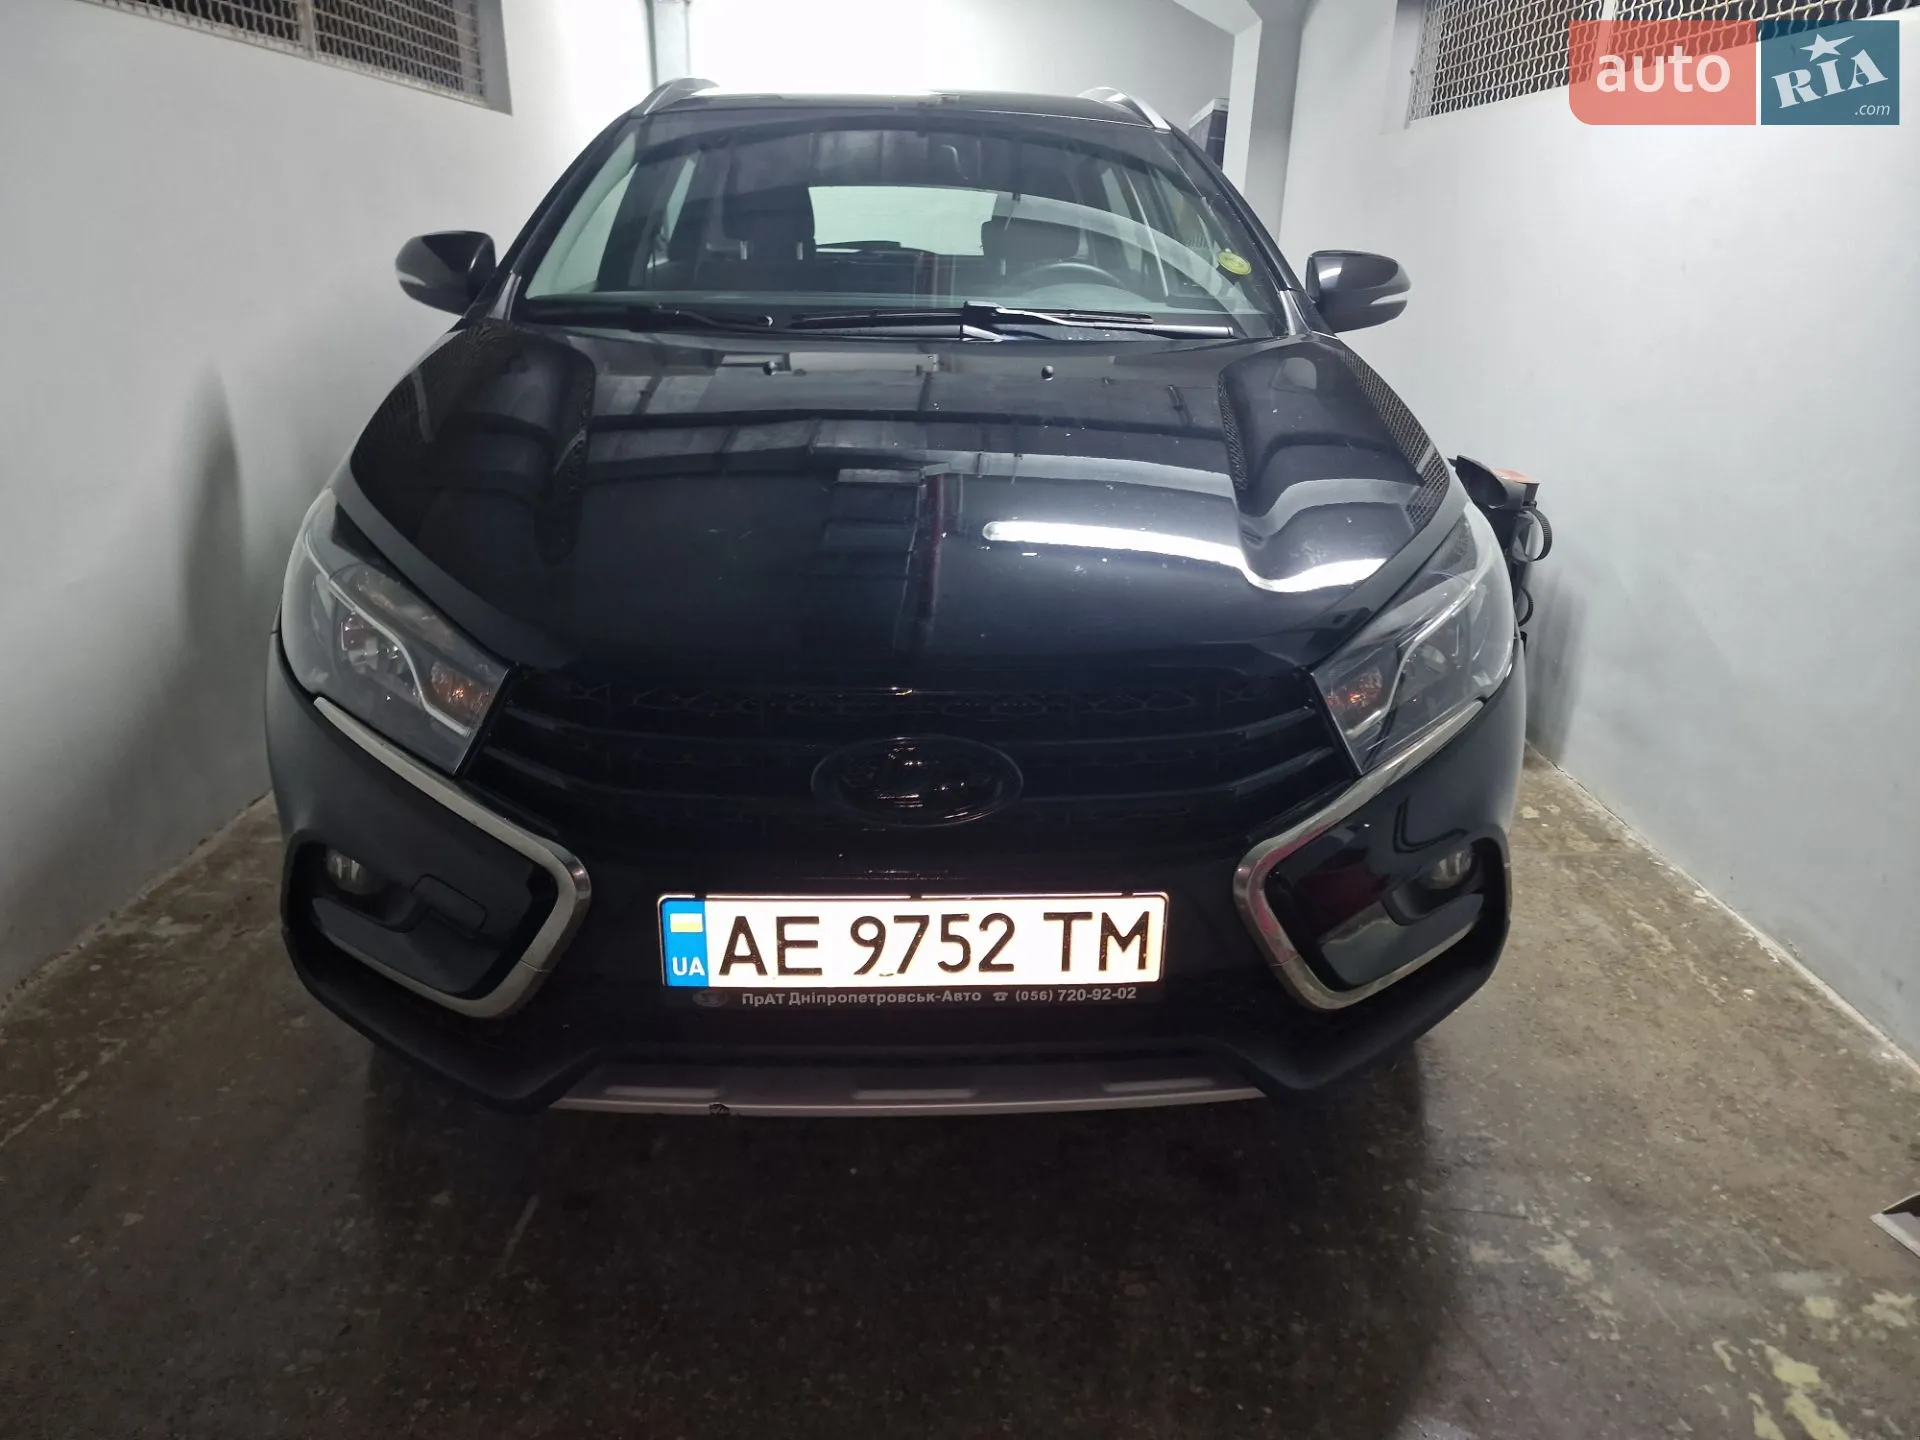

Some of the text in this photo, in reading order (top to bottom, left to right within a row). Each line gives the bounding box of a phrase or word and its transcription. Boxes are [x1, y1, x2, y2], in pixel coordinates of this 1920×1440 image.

[718, 910, 1151, 976] AE 9752 TM
[672, 956, 706, 977] UA
[741, 986, 1138, 1007] ПрАТ Дніпропетровськ-Авто (056) 720-92-02
